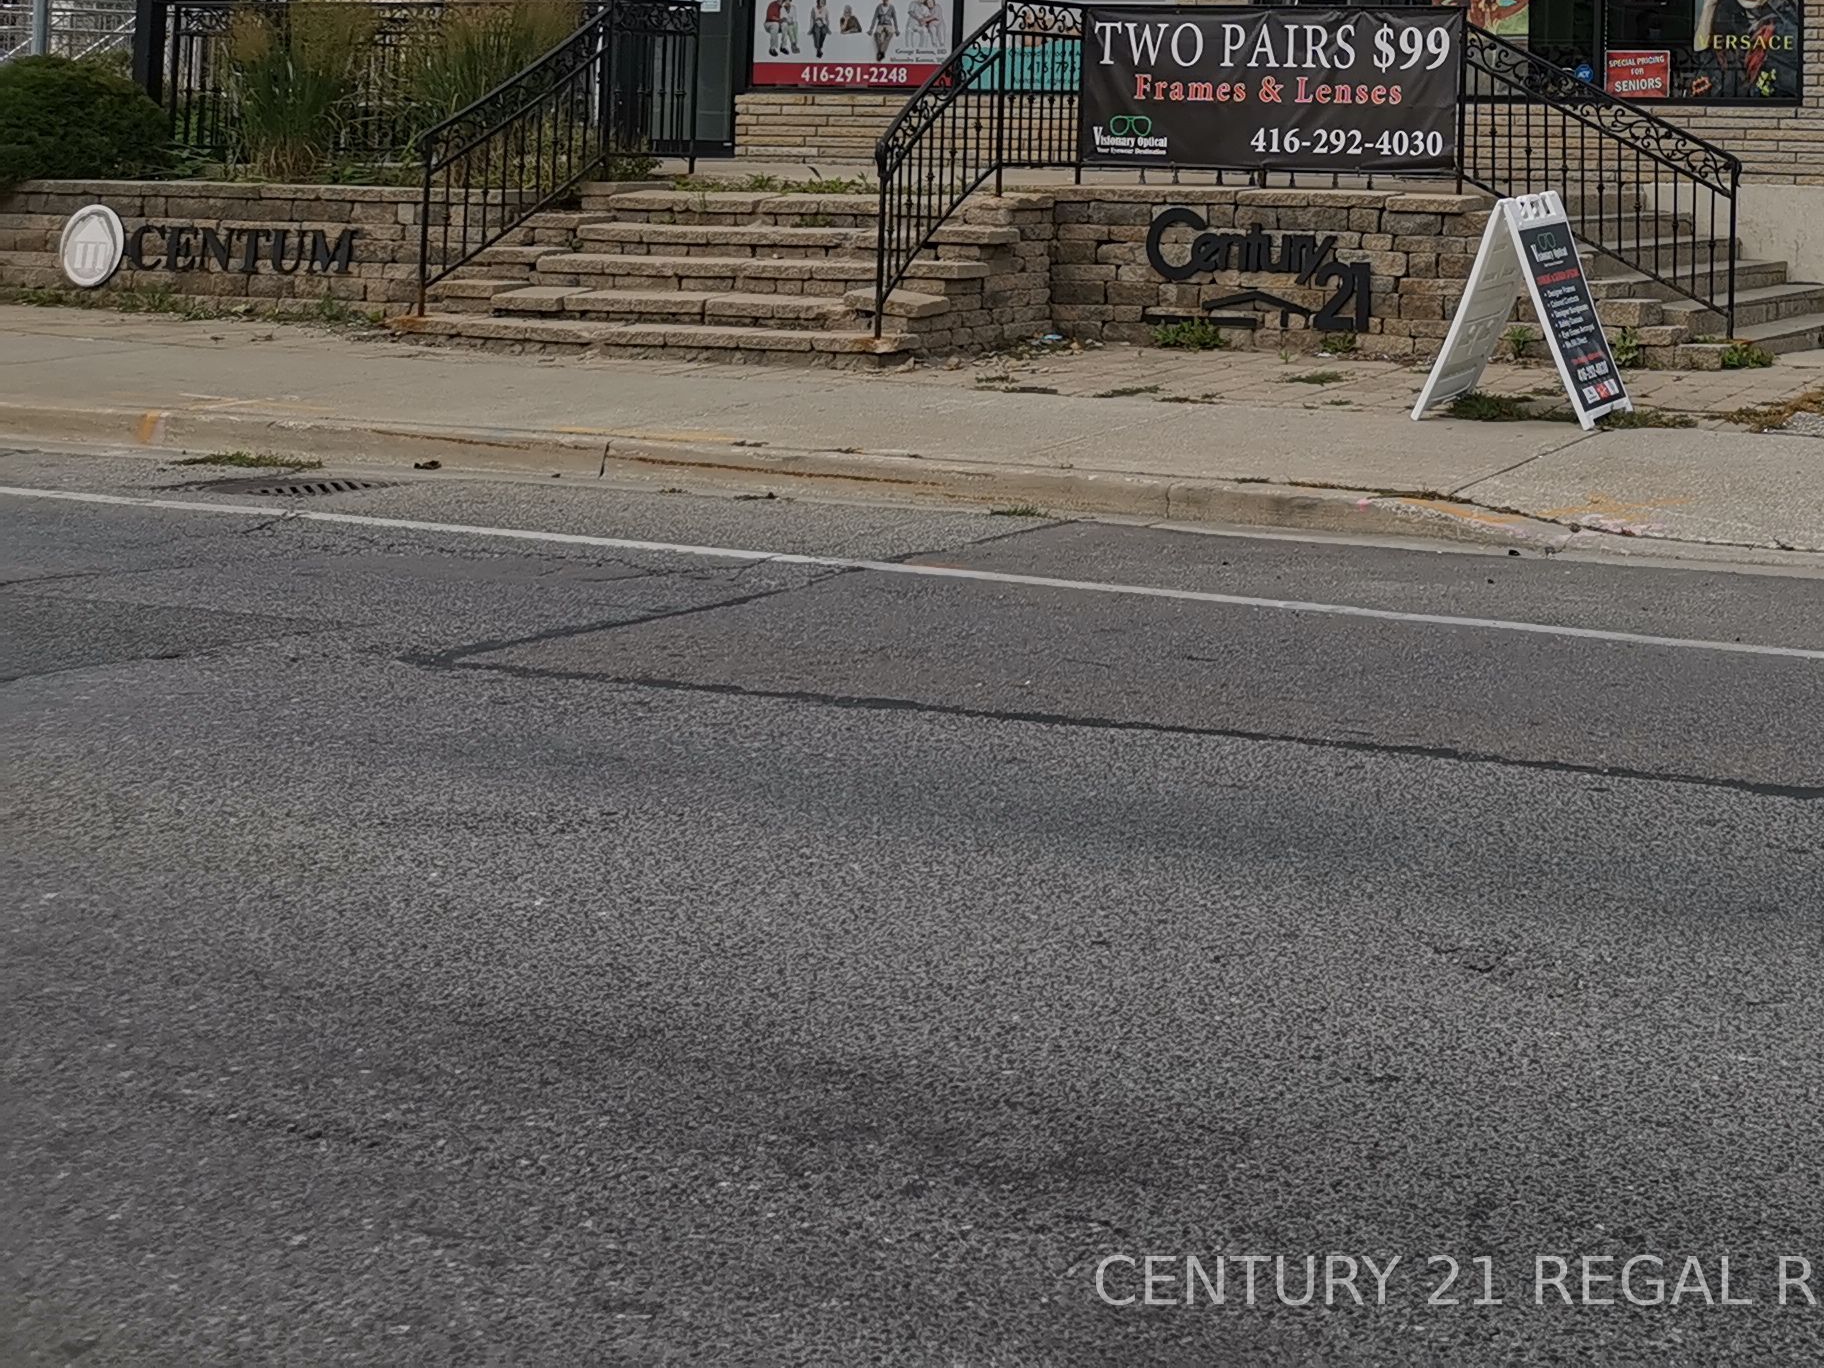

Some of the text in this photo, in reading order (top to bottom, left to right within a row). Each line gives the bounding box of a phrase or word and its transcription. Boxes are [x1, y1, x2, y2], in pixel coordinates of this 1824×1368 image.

[1094, 21, 1451, 74] TWO PAIRS $99
[1699, 34, 1794, 51] VERSACE
[1608, 55, 1665, 68] SPECIAL PRICING
[1631, 67, 1645, 75] FOR
[800, 66, 908, 83] 416-291-2248
[1614, 76, 1663, 92] SENIORS
[1134, 73, 1402, 105] Frames & Lenses
[1092, 126, 1168, 148] Visionary Optical
[1250, 127, 1443, 157] 416-292-4030
[127, 224, 360, 275] CENTUM
[1145, 208, 1371, 331] Century 21
